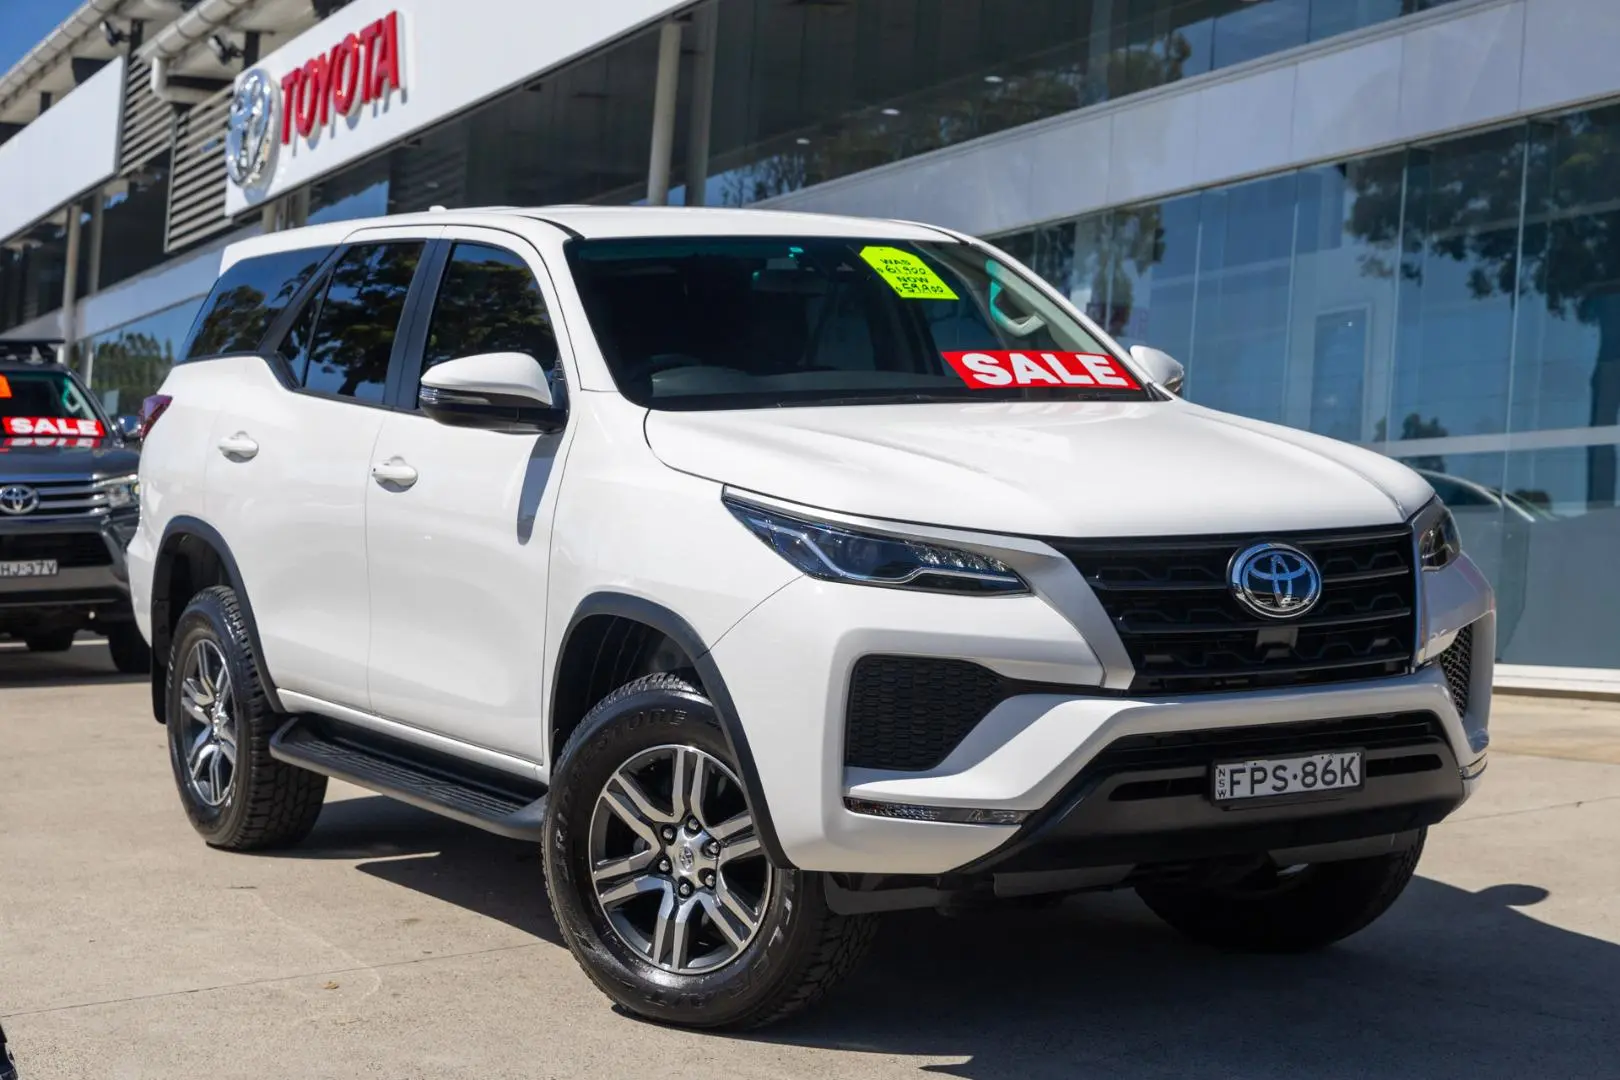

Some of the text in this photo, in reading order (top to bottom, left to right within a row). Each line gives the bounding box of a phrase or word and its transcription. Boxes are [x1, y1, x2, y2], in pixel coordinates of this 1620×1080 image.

[281, 10, 400, 145] TOYOTA
[962, 352, 1129, 386] SALE
[10, 417, 100, 436] SALE
